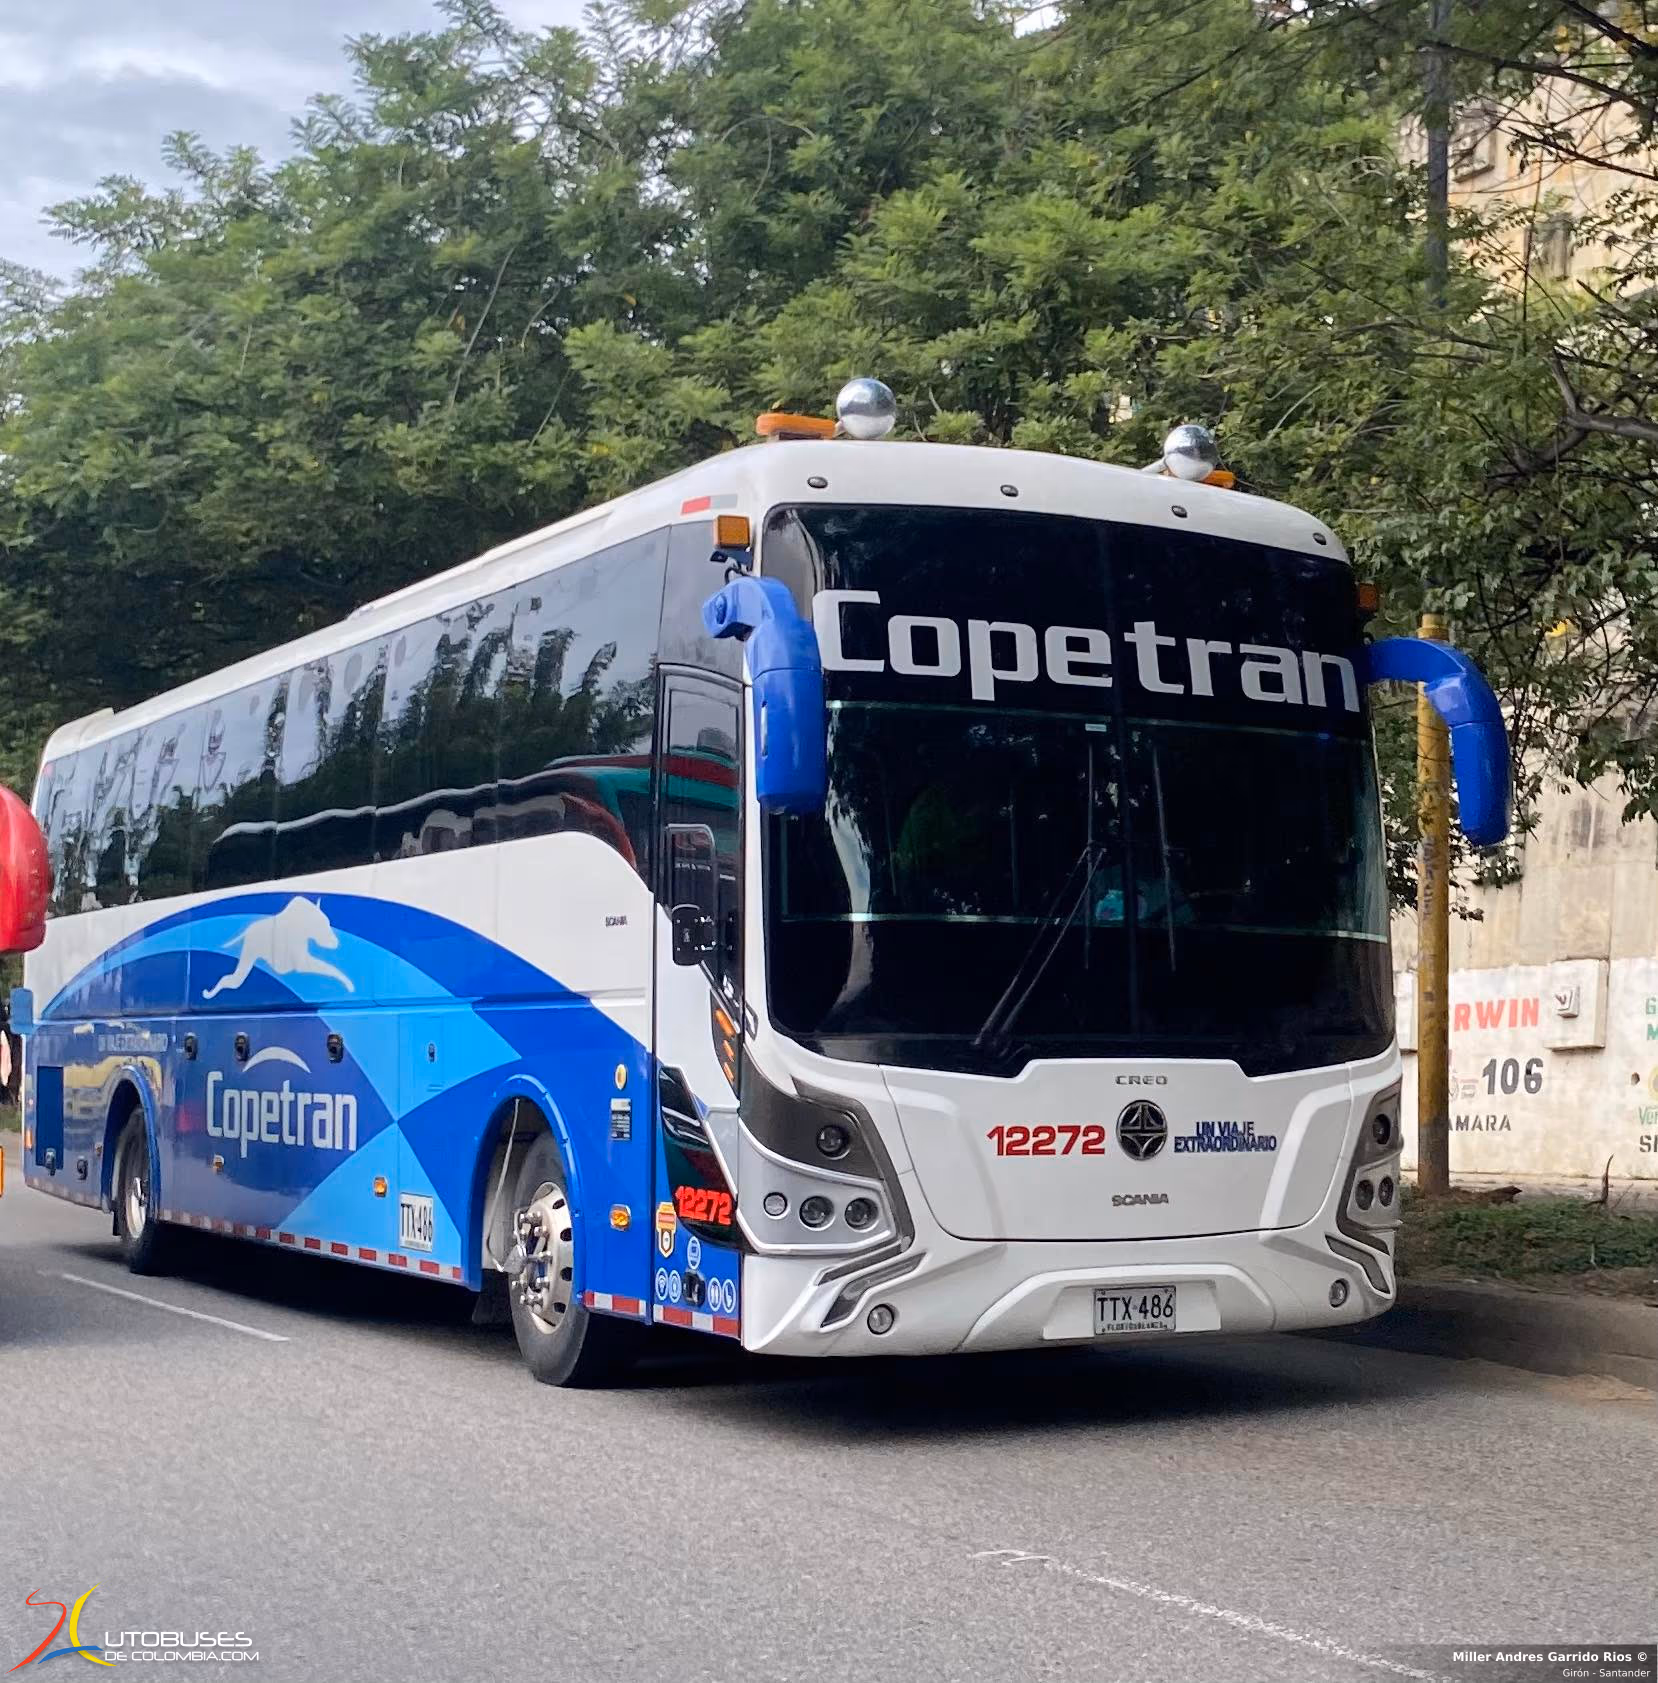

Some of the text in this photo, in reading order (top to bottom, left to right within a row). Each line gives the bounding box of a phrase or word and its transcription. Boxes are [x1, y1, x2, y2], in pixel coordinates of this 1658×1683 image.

[812, 589, 1360, 713] Copetran
[1454, 998, 1540, 1032] RWIN
[1115, 1075, 1168, 1085] CREO
[1482, 1057, 1544, 1095] 106
[206, 1071, 357, 1159] Copetran
[1196, 1121, 1255, 1137] UN VIAJE
[986, 1125, 1106, 1156] 12272
[1173, 1135, 1277, 1153] EXTRAORDINARIO
[676, 1186, 733, 1226] 12272
[1111, 1194, 1169, 1206] SCANIA
